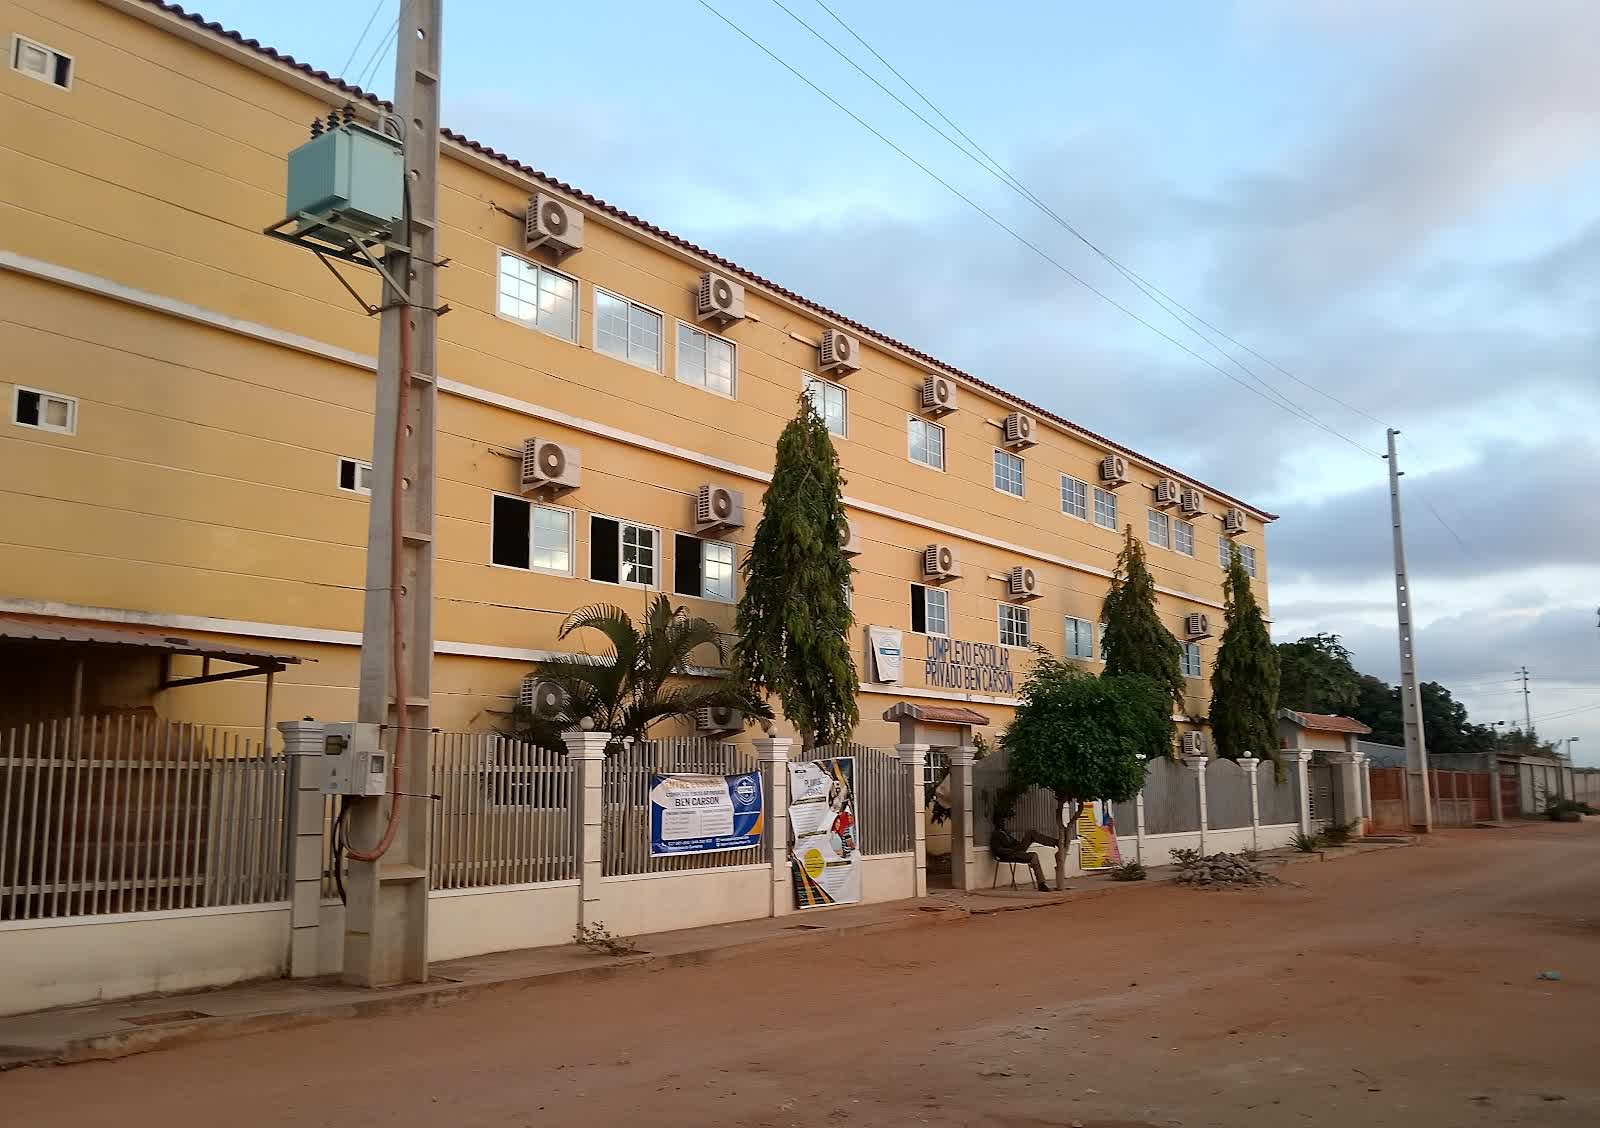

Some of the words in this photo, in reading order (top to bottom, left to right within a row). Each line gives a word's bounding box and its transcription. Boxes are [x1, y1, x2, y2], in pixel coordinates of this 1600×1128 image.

[925, 661, 962, 689] PRIVADO
[965, 666, 981, 691] BEN
[982, 668, 1014, 695] CARSON
[675, 798, 690, 807] BEN
[691, 796, 720, 806] CARSON
